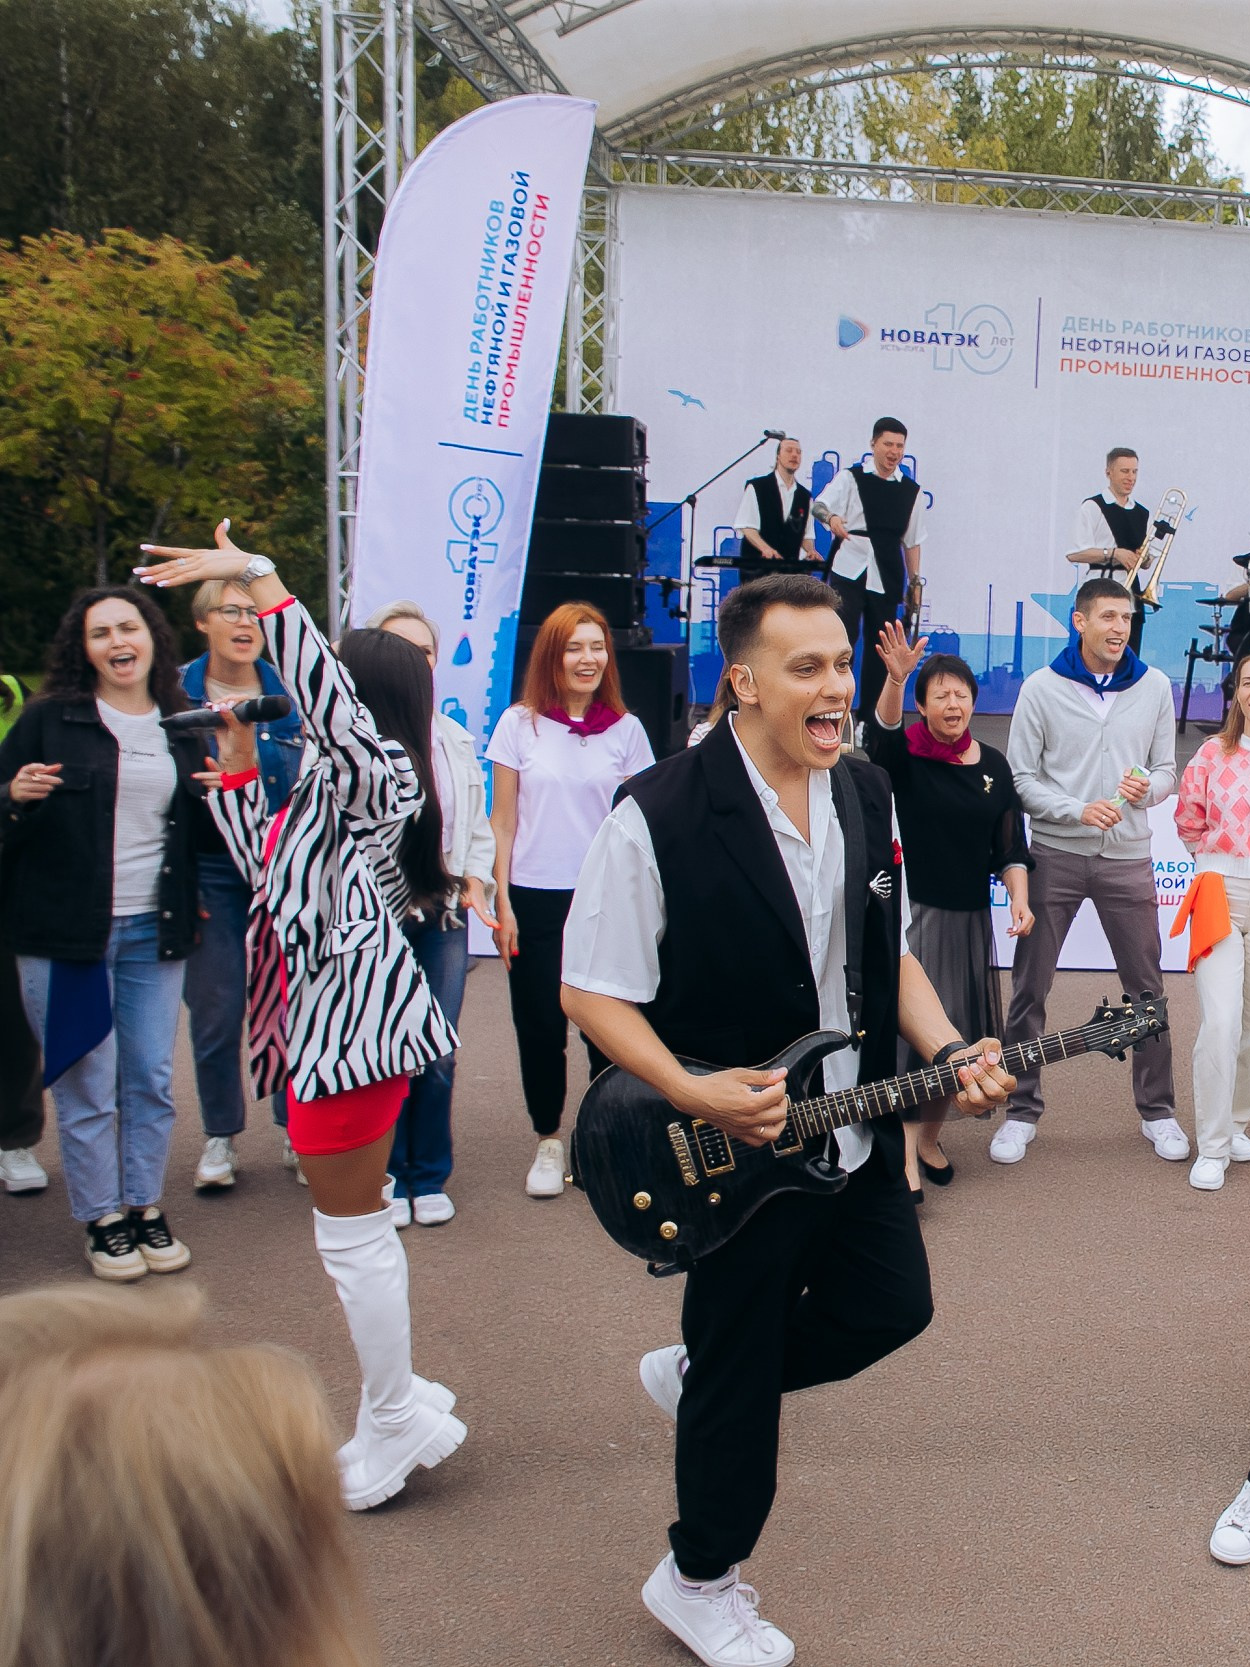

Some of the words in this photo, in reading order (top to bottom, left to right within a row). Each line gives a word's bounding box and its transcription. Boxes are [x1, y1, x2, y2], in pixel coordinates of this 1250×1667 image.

[502, 170, 530, 276] ГАЗОВОЙ
[470, 199, 505, 355] РАБОТНИКОВ
[498, 281, 512, 297] И
[497, 193, 550, 428] ПРОМЫШЛЕННОСТИ
[881, 328, 980, 347] НОВАТЭК
[1062, 316, 1117, 334] ДЕНЬ
[481, 302, 508, 424] НЕФТЯНОЙ
[990, 336, 1016, 347] лет
[1061, 337, 1170, 357] НЕФТЯНОЙ
[1176, 344, 1188, 358] И
[463, 361, 482, 422] ДЕНЬ
[463, 514, 482, 620] НОВАТЭК
